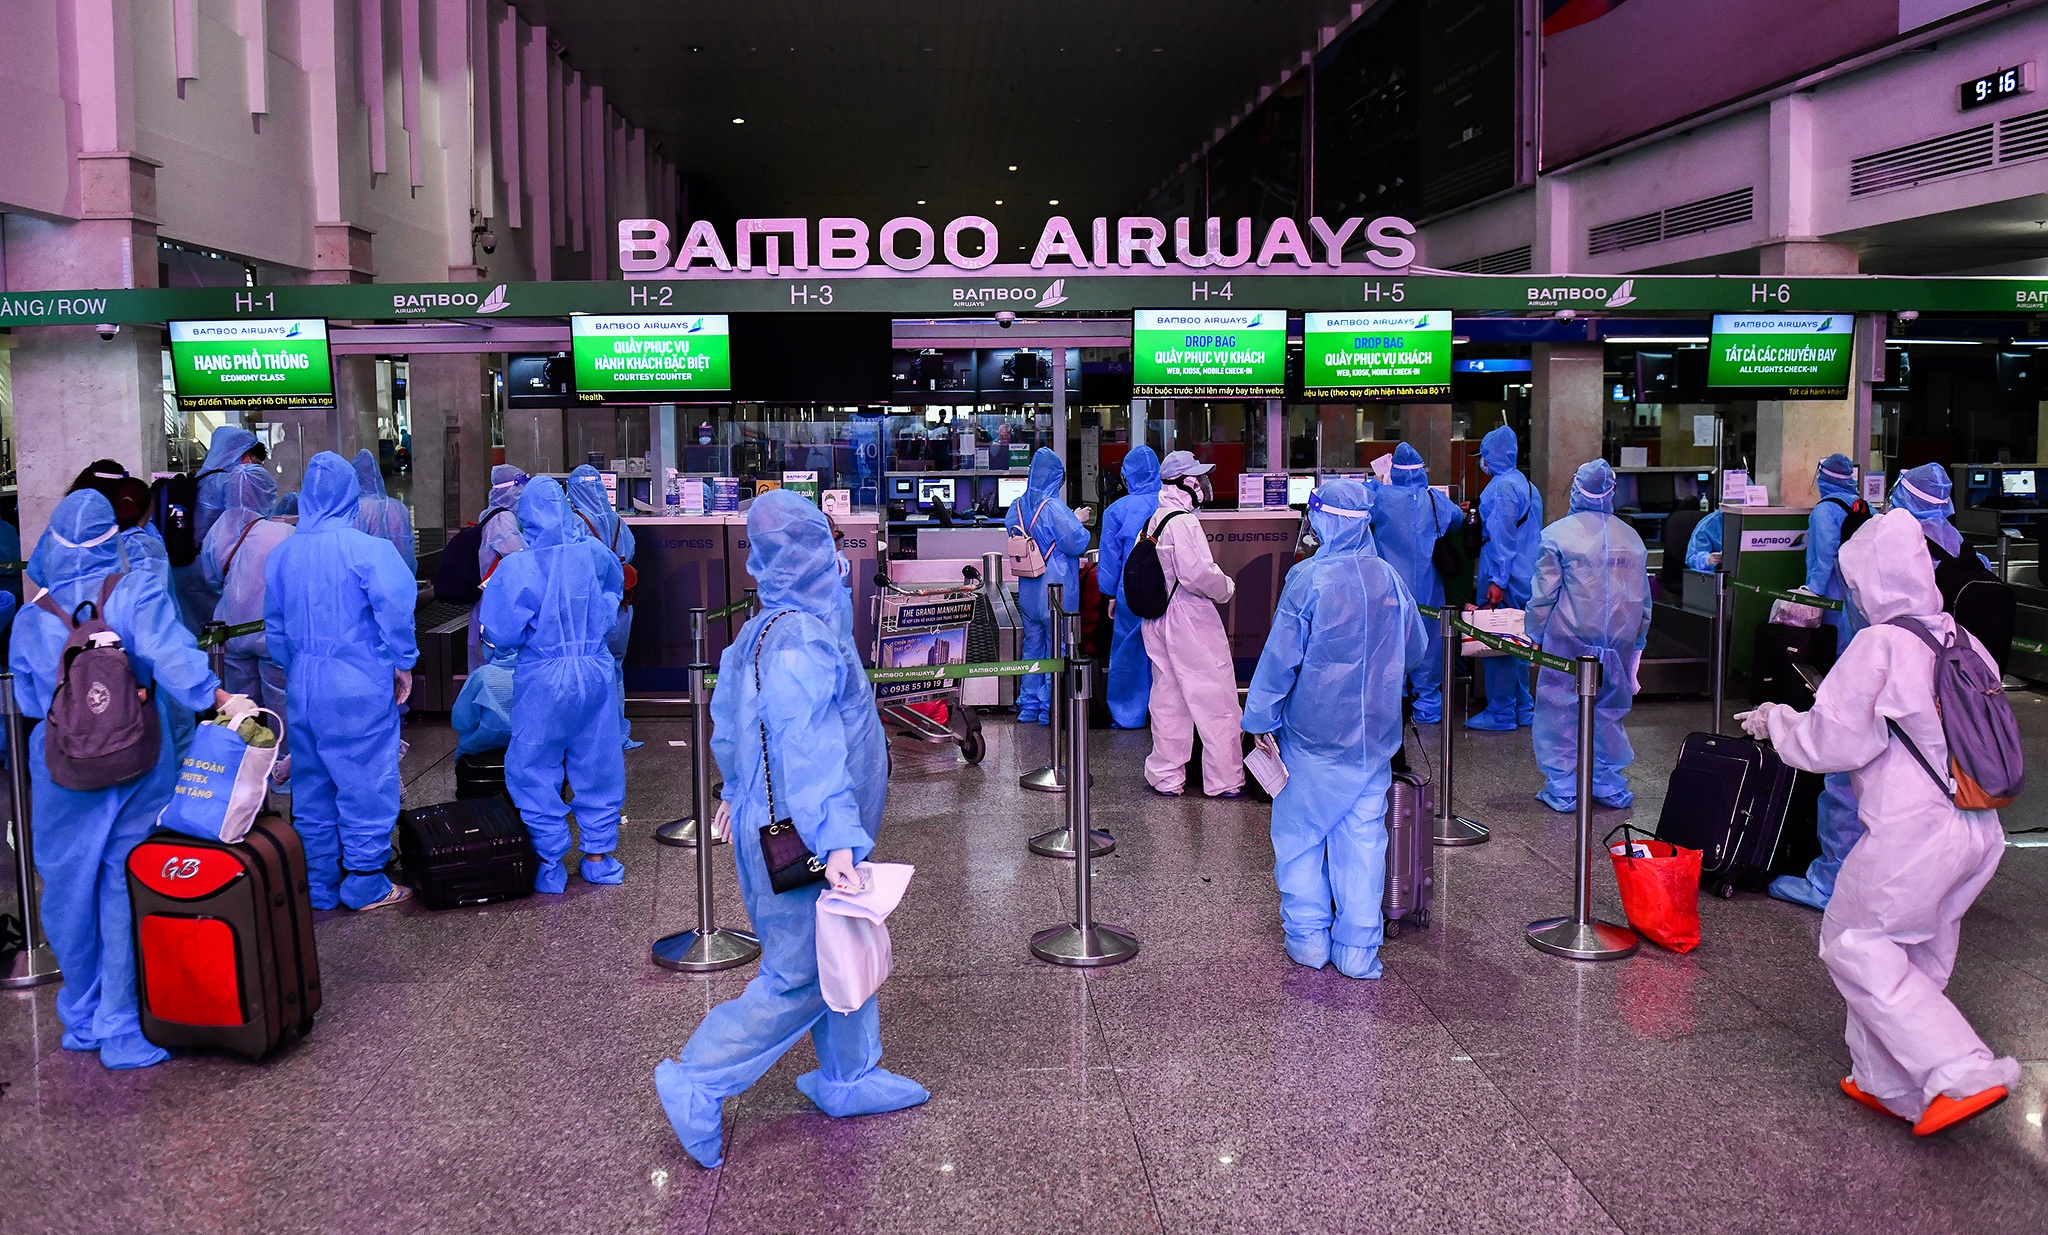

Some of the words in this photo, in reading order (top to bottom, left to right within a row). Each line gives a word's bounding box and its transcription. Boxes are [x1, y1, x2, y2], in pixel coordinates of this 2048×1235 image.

[1976, 70, 2015, 101] 9:16
[618, 216, 998, 275] BAMBOO
[1030, 216, 1416, 268] AIRWAYS
[393, 293, 478, 307] BAMBOO
[630, 287, 673, 306] H-2
[791, 285, 833, 305] H-3
[952, 287, 1037, 301] BAMBOO
[1192, 281, 1233, 301] H-4
[1364, 282, 1405, 302] H-5
[1527, 287, 1607, 301] BAMBOO
[1752, 284, 1791, 303] H-6
[235, 292, 274, 312] H-1
[614, 336, 643, 354] QUẦY
[644, 341, 674, 356] PHỤC
[674, 340, 689, 356] VỤ
[1185, 335, 1213, 347] DROP
[1215, 335, 1236, 347] BAG
[1354, 337, 1382, 349] DROP
[1384, 337, 1404, 349] BAG
[193, 354, 232, 374] HẠNG
[233, 348, 262, 370] PHỔ
[262, 350, 309, 369] THÔNG
[1155, 346, 1184, 364] QUẦY
[1184, 351, 1212, 366] PHỤC
[1214, 351, 1228, 366] VỤ
[1230, 348, 1265, 364] KHÁCH
[1325, 349, 1353, 366] QUẦY
[1353, 352, 1380, 368] PHỤC
[1382, 352, 1397, 367] VỤ
[1398, 349, 1432, 365] KHÁCH
[1725, 343, 1743, 362] TẤT
[1744, 344, 1756, 362] CẢ
[1757, 345, 1777, 362] CÁC
[1778, 343, 1816, 362] CHUYẾN
[1817, 348, 1837, 361] BAY
[594, 354, 624, 370] HÀNH
[626, 354, 662, 370] KHÁCH
[664, 354, 686, 372] ĐẶC
[688, 353, 710, 372] BIỆT
[1202, 367, 1224, 375] MOBILE
[1225, 367, 1252, 375] CHECK-IN
[1372, 368, 1393, 376] MOBILE
[1393, 368, 1420, 376] CHECK-IN
[221, 374, 259, 382] ECONOMY
[260, 373, 285, 381] CLASS
[613, 373, 654, 381] COURTESY
[655, 373, 692, 381] COUNTER
[579, 393, 605, 401] Health.
[660, 540, 714, 548] USINESS
[1228, 532, 1288, 542] BUSINESS
[903, 608, 914, 618] THE
[916, 607, 936, 617] GRAND
[936, 604, 972, 614] MANHATTAN
[890, 684, 910, 693] 0938
[923, 681, 931, 689] 19
[161, 856, 201, 881] GB
